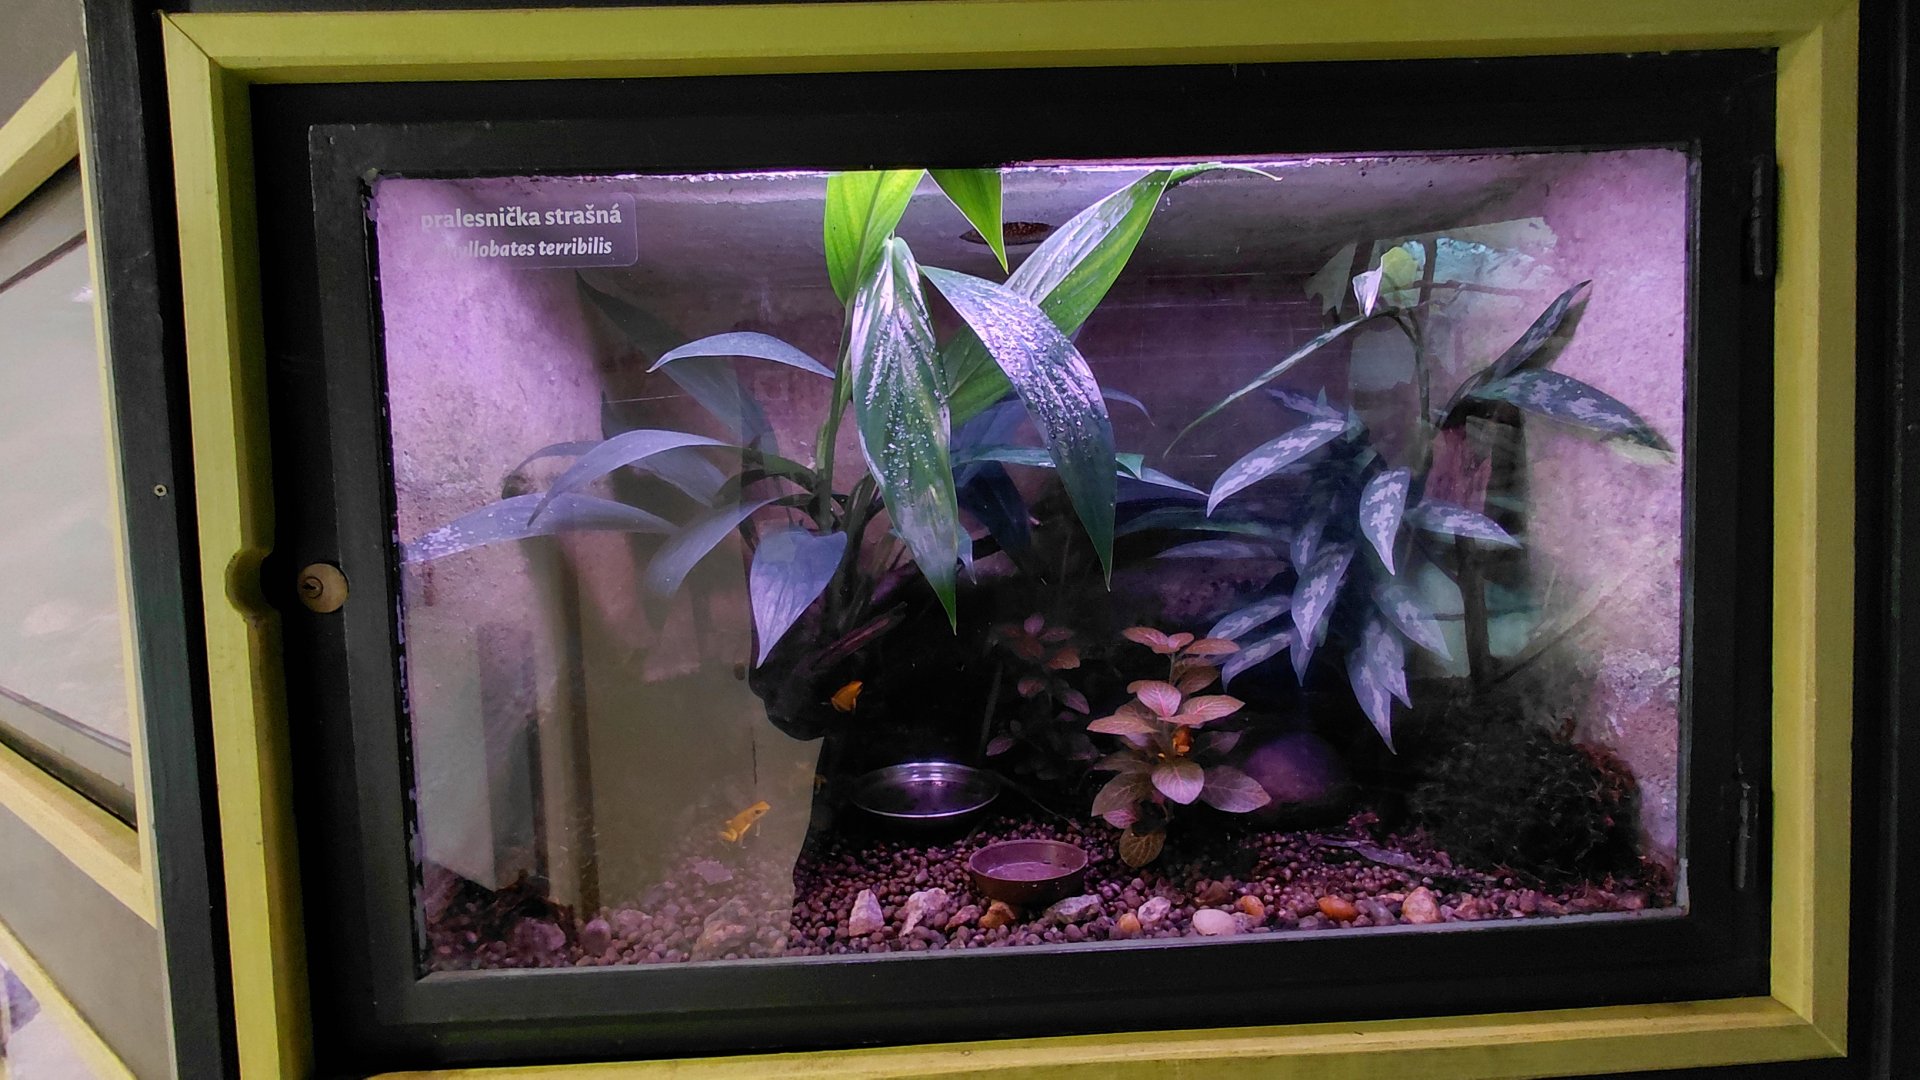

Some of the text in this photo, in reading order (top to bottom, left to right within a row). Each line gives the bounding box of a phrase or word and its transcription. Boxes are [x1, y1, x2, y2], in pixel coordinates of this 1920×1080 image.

[421, 203, 621, 233] pralesnička strašná
[538, 237, 613, 256] terribilis
